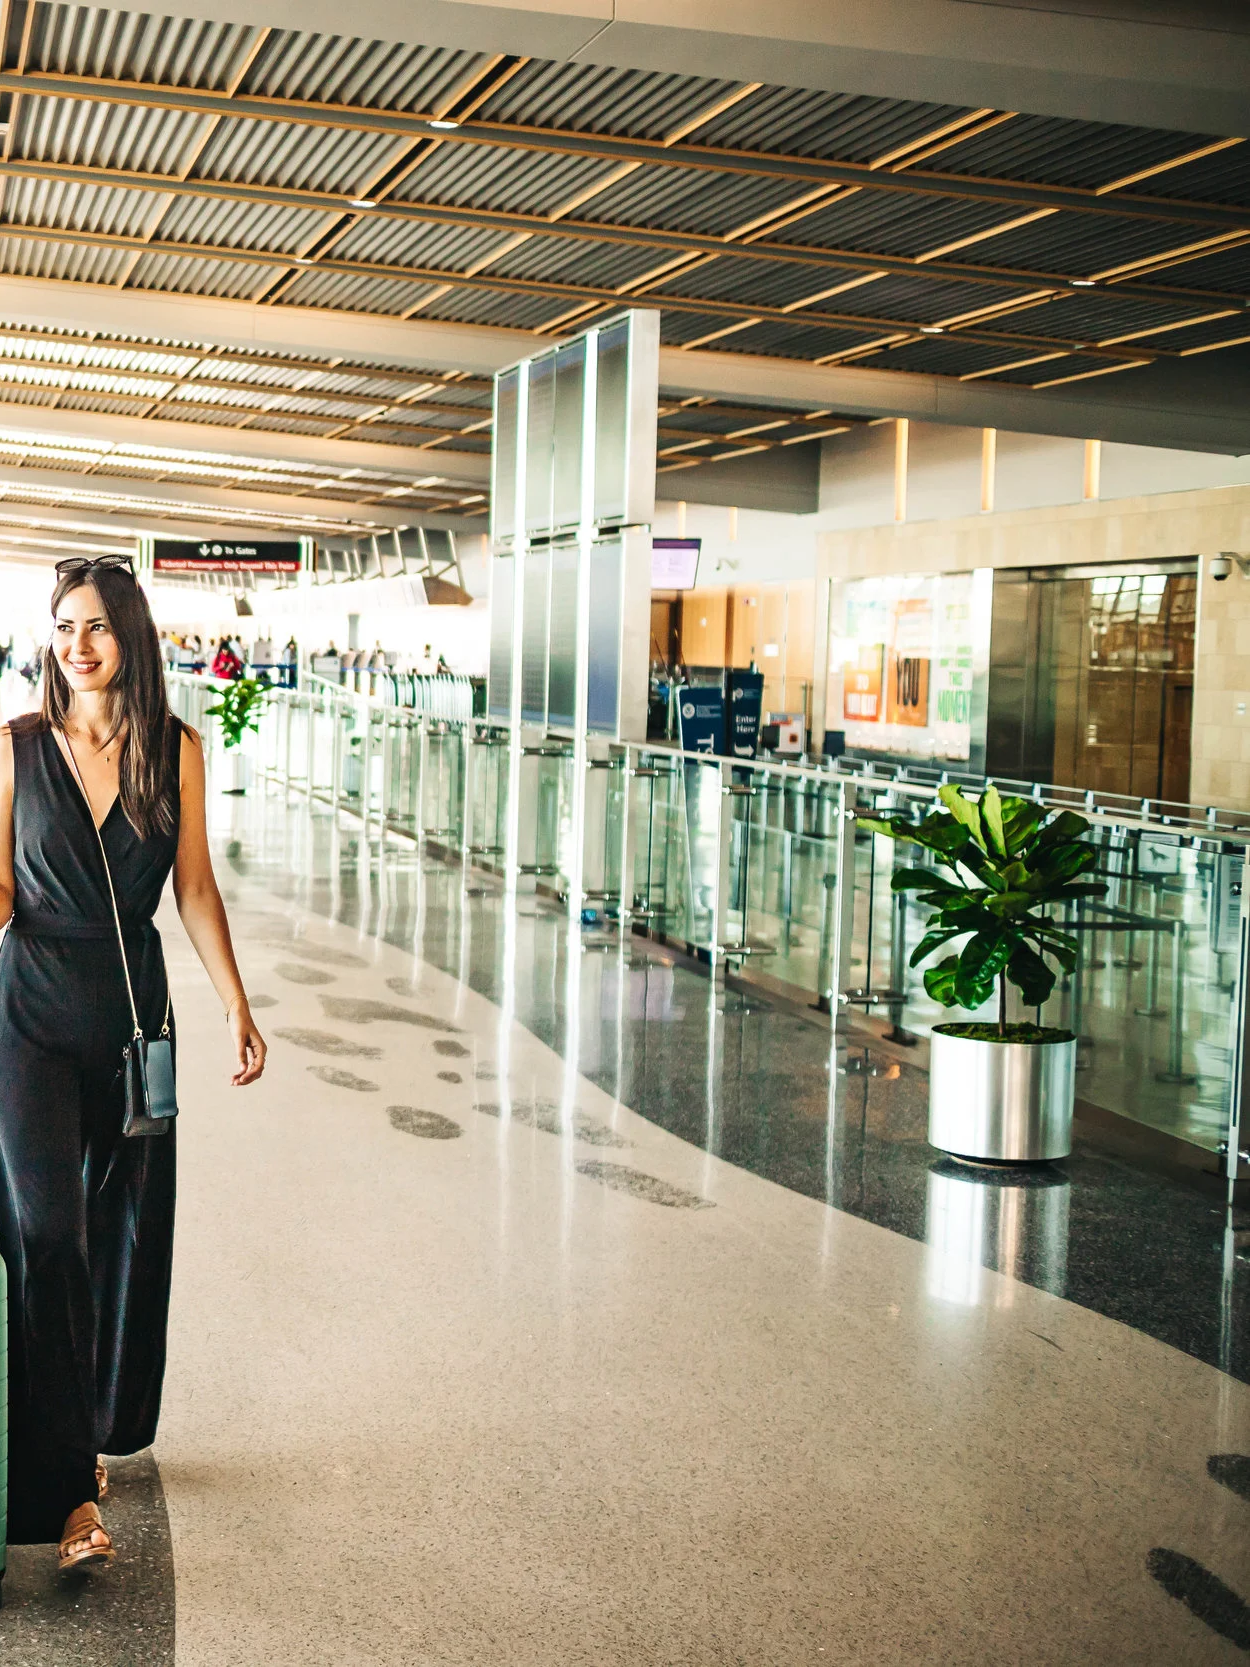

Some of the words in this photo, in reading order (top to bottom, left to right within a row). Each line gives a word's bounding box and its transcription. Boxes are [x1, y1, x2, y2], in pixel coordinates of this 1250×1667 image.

[225, 546, 234, 555] To
[235, 546, 257, 555] Gates
[159, 560, 187, 569] Ticketed
[187, 561, 223, 570] Passengers
[223, 562, 239, 570] Only
[264, 561, 278, 570] This
[735, 715, 756, 723] Enter
[736, 725, 755, 733] Here
